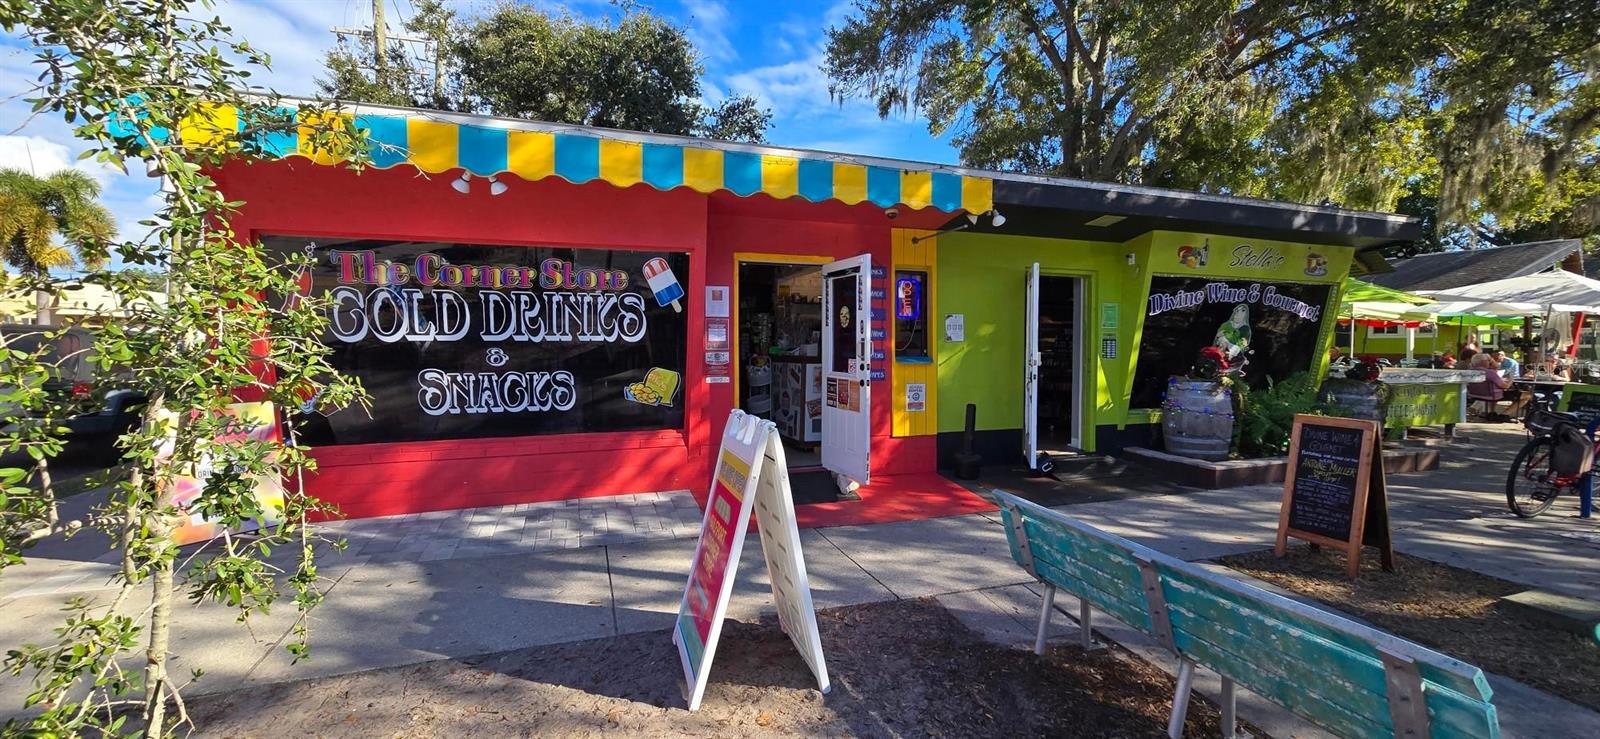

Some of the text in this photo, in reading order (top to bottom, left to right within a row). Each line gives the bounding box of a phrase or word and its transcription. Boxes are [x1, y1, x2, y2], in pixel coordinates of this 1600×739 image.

[330, 250, 629, 290] The Corner Store
[1229, 244, 1285, 268] Stella's
[326, 286, 471, 343] COLD
[478, 290, 647, 343] DRINKS
[1149, 282, 1321, 322] Divine Wine & Gourmet
[486, 348, 509, 366] &
[418, 368, 577, 416] SNACKS
